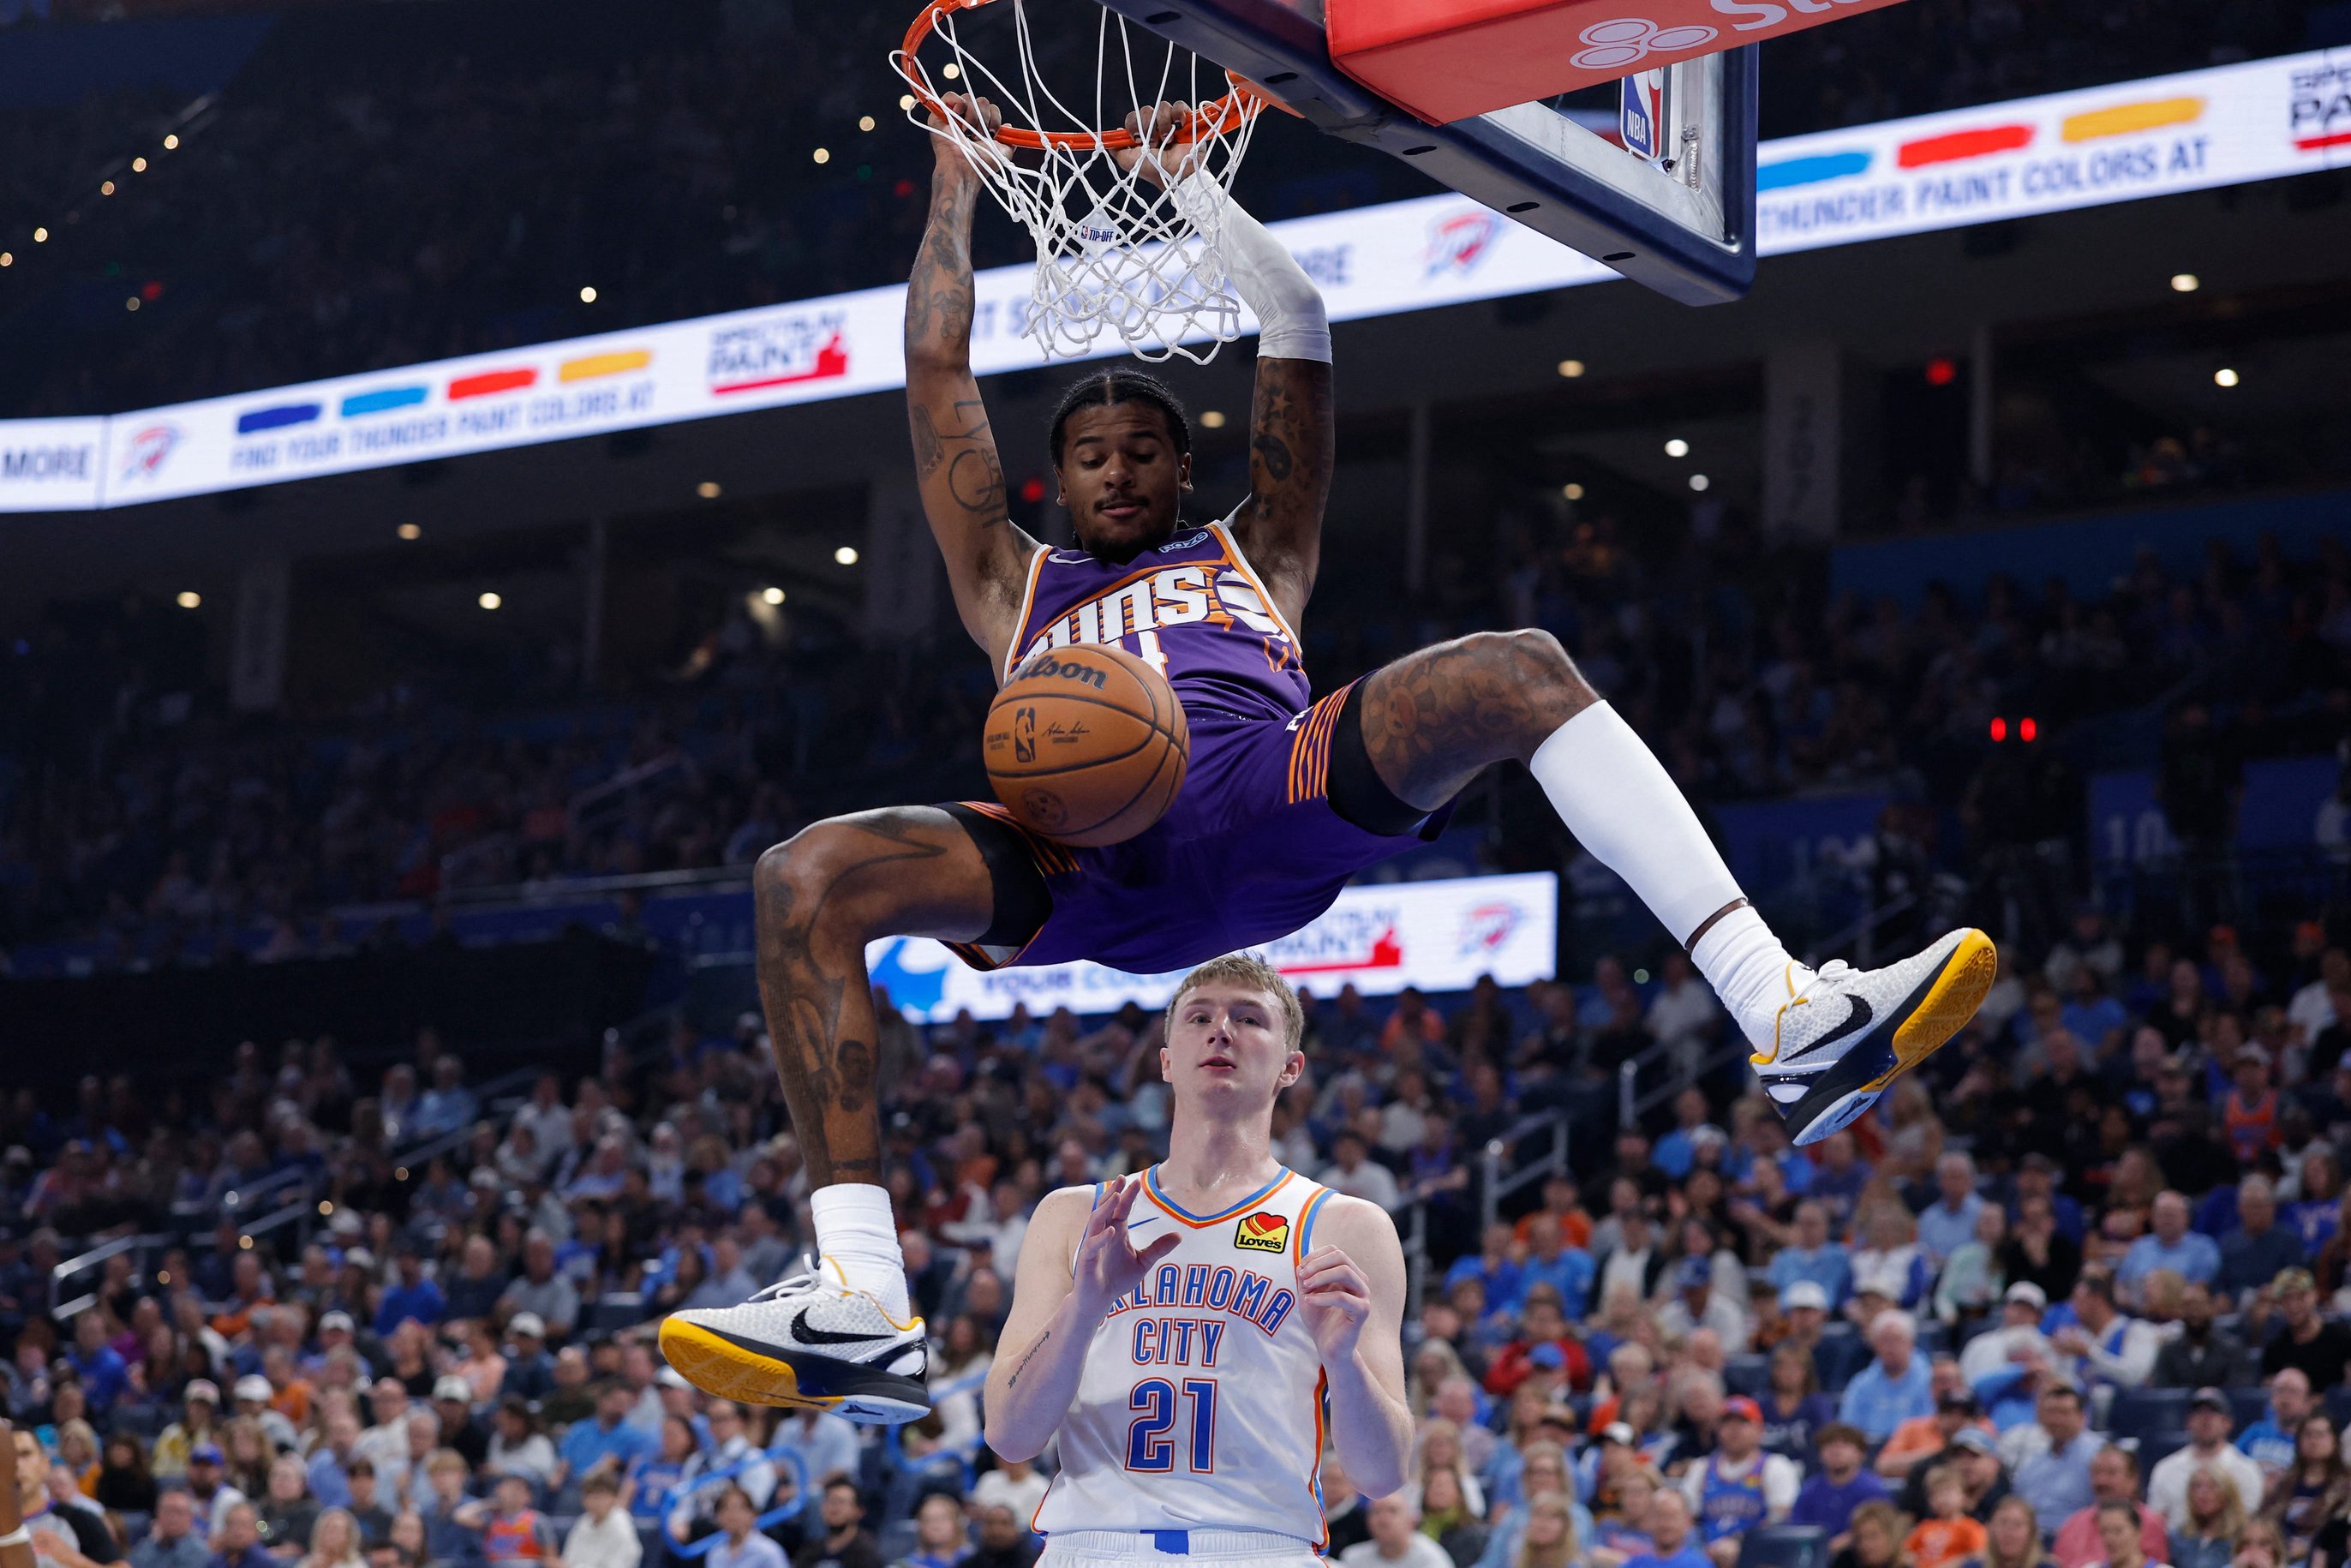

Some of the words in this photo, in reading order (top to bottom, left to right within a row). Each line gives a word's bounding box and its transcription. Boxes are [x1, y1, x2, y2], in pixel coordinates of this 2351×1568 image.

[1627, 109, 1647, 146] NBA
[1759, 185, 1905, 236] THUNDER
[1914, 169, 2016, 215] PAINT
[2024, 144, 2157, 195] COLORS
[2169, 135, 2211, 173] AT
[1089, 230, 1114, 242] TIP-OFF
[288, 432, 340, 461] YOUR
[350, 413, 446, 452] THUNDER
[461, 403, 521, 435] PAINT
[529, 390, 617, 426] COLORS
[627, 380, 655, 410] AT
[3, 444, 92, 481] MORE
[1159, 532, 1208, 553] paze
[1011, 655, 1108, 691] ilson
[1131, 1317, 1225, 1368] CITY
[1124, 1377, 1218, 1475] 21
